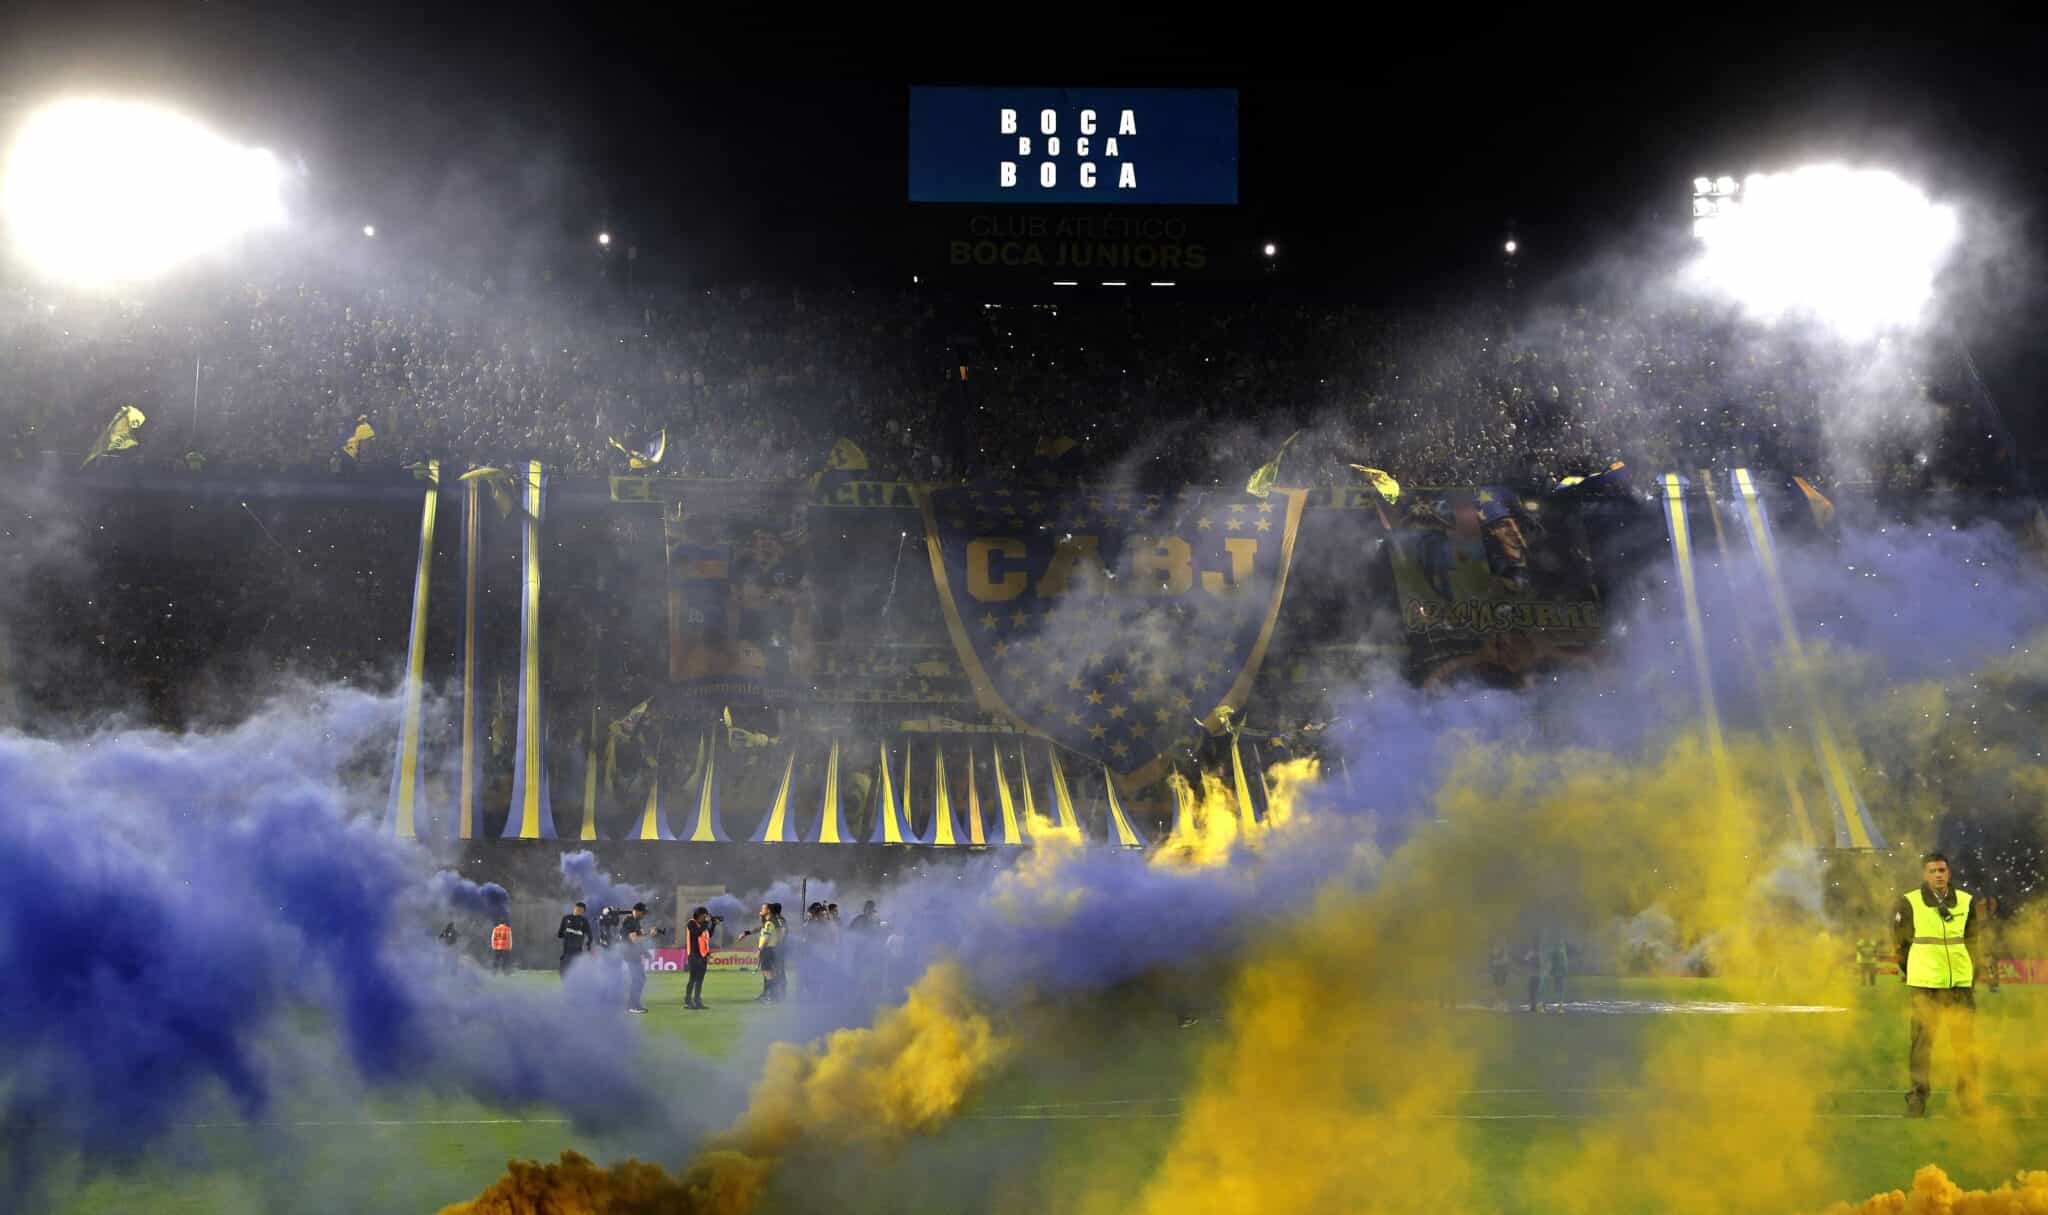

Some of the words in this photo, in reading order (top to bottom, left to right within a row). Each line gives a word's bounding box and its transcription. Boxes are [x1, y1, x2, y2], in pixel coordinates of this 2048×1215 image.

[1000, 108, 1136, 135] BOCA
[1018, 136, 1119, 156] BOCA
[1000, 161, 1136, 188] BOCA
[969, 215, 1047, 239] CLUB
[1056, 211, 1186, 239] ATLÉTICO
[950, 240, 1045, 266] BOCA
[1056, 240, 1209, 270] JUNIORS
[966, 535, 1258, 601] CABJ
